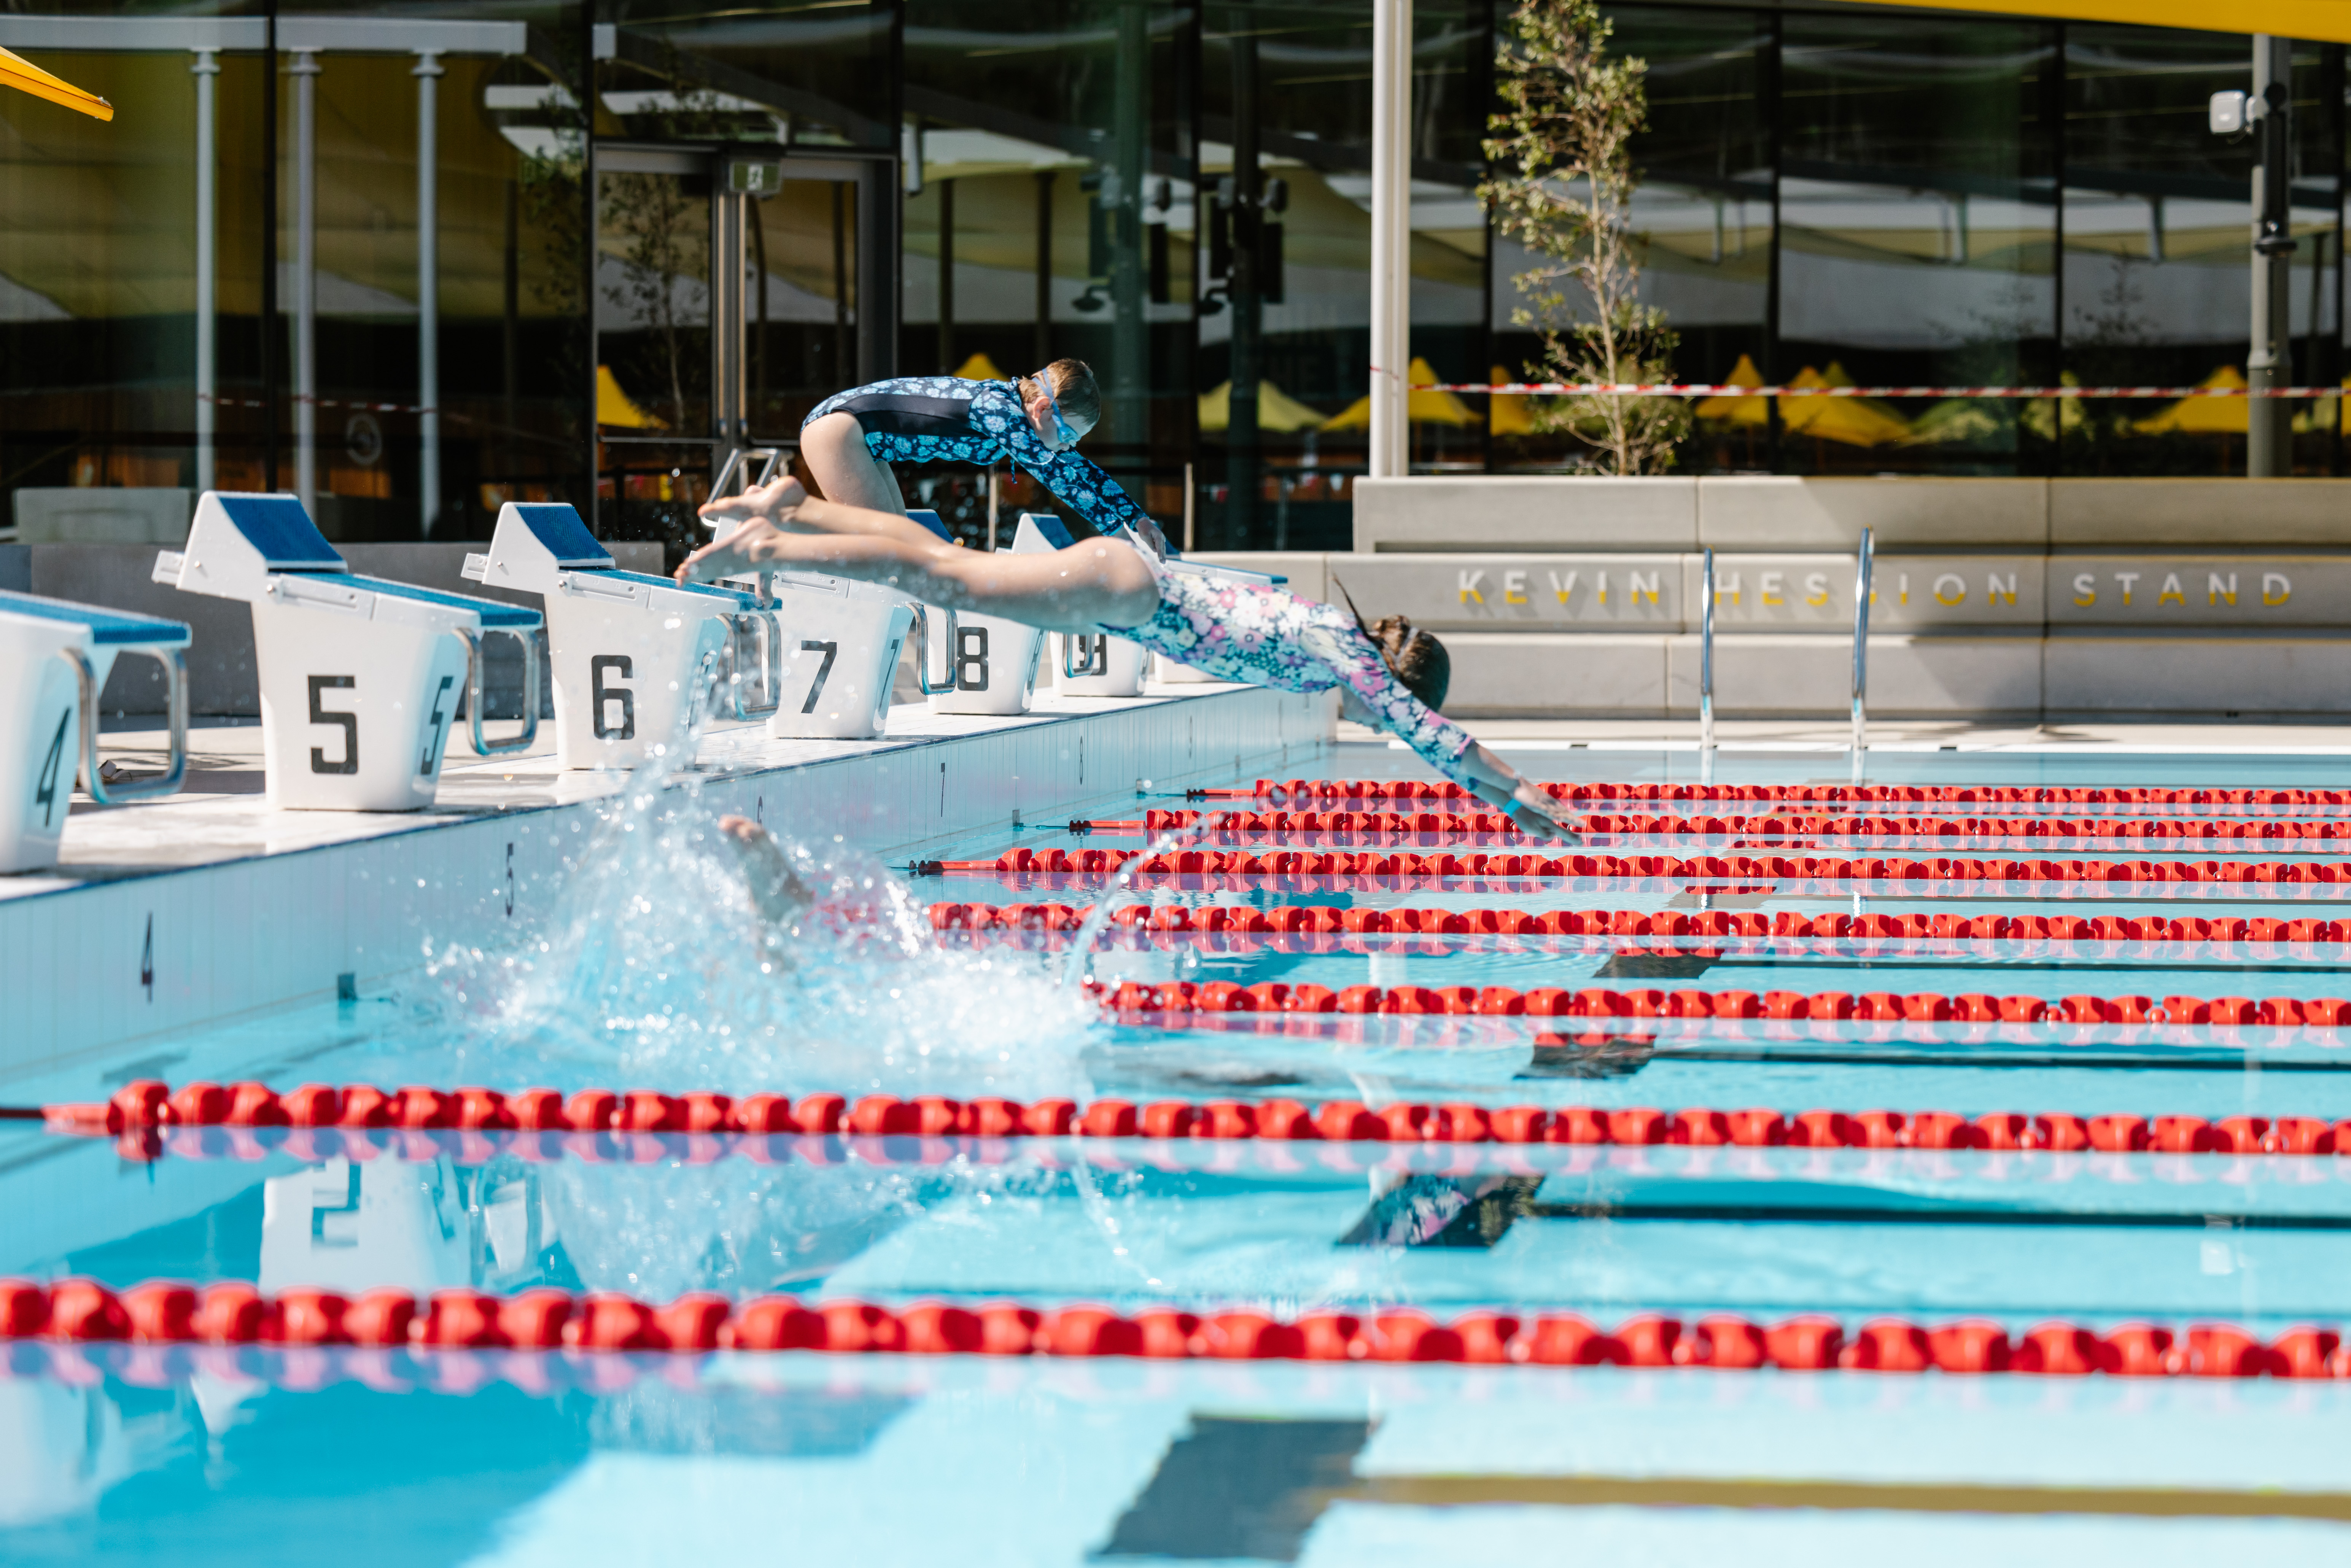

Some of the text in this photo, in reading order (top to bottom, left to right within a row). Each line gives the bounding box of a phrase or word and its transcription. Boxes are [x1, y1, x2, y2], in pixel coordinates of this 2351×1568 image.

[1459, 570, 1659, 604] KEVIN
[2073, 572, 2292, 606] STAND
[592, 655, 635, 740] 6
[801, 640, 837, 714] 7
[878, 639, 900, 712] 7
[958, 627, 988, 691] 8
[308, 675, 358, 774] 5
[421, 676, 454, 775] 5
[37, 706, 72, 827] 4
[506, 843, 514, 916] 5
[142, 911, 154, 1003] 4
